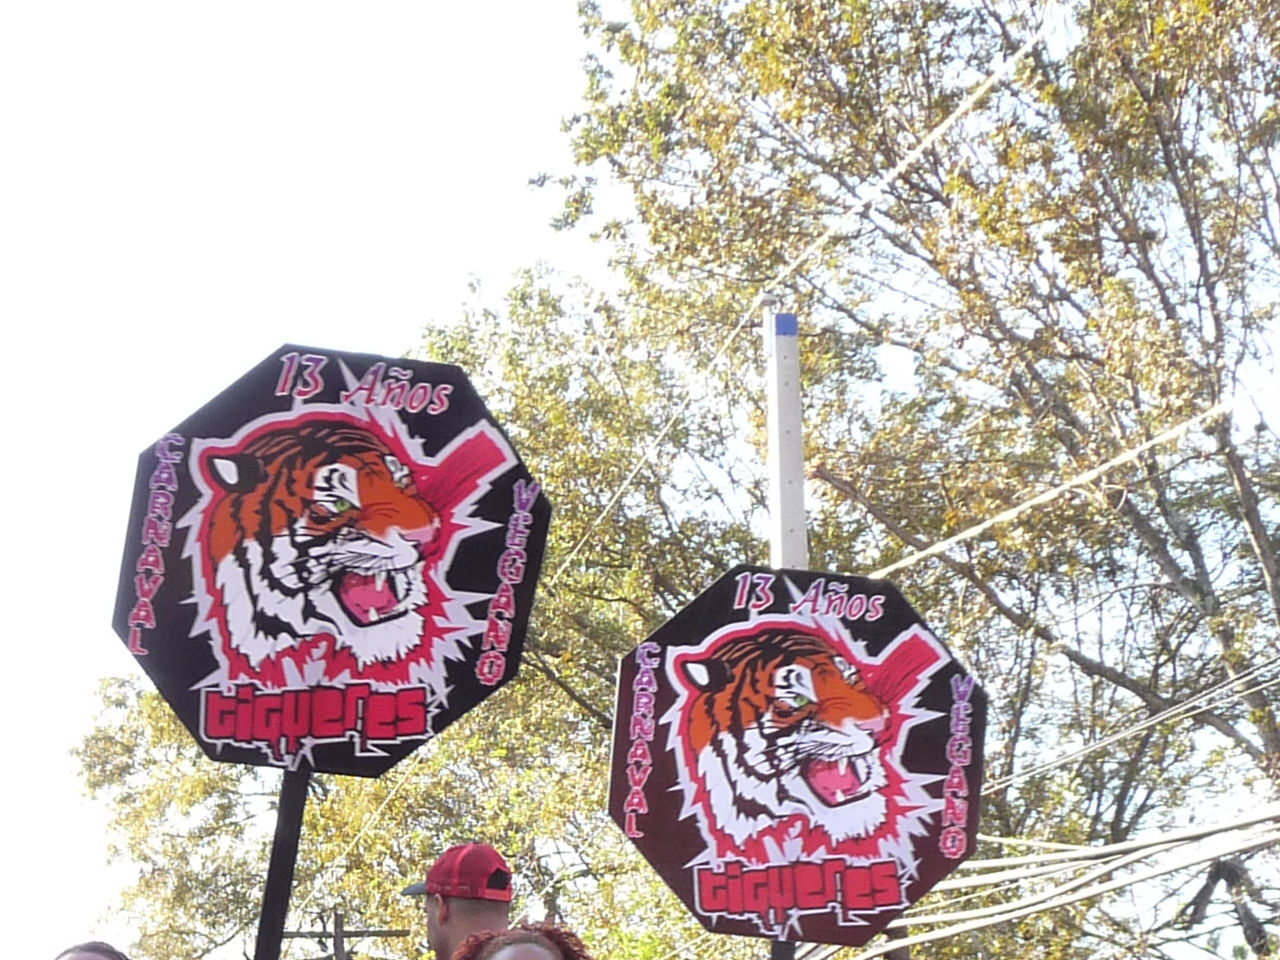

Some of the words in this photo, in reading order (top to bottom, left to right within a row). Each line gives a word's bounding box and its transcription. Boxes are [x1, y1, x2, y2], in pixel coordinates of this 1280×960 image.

[275, 353, 328, 398] 13
[341, 363, 454, 415] Años
[128, 433, 185, 655] CARNAVAL
[476, 480, 539, 686] VEGANO
[733, 572, 775, 611] 13
[791, 578, 885, 621] Años
[624, 642, 661, 838] CARNAVAL
[939, 674, 974, 859] VEGANO
